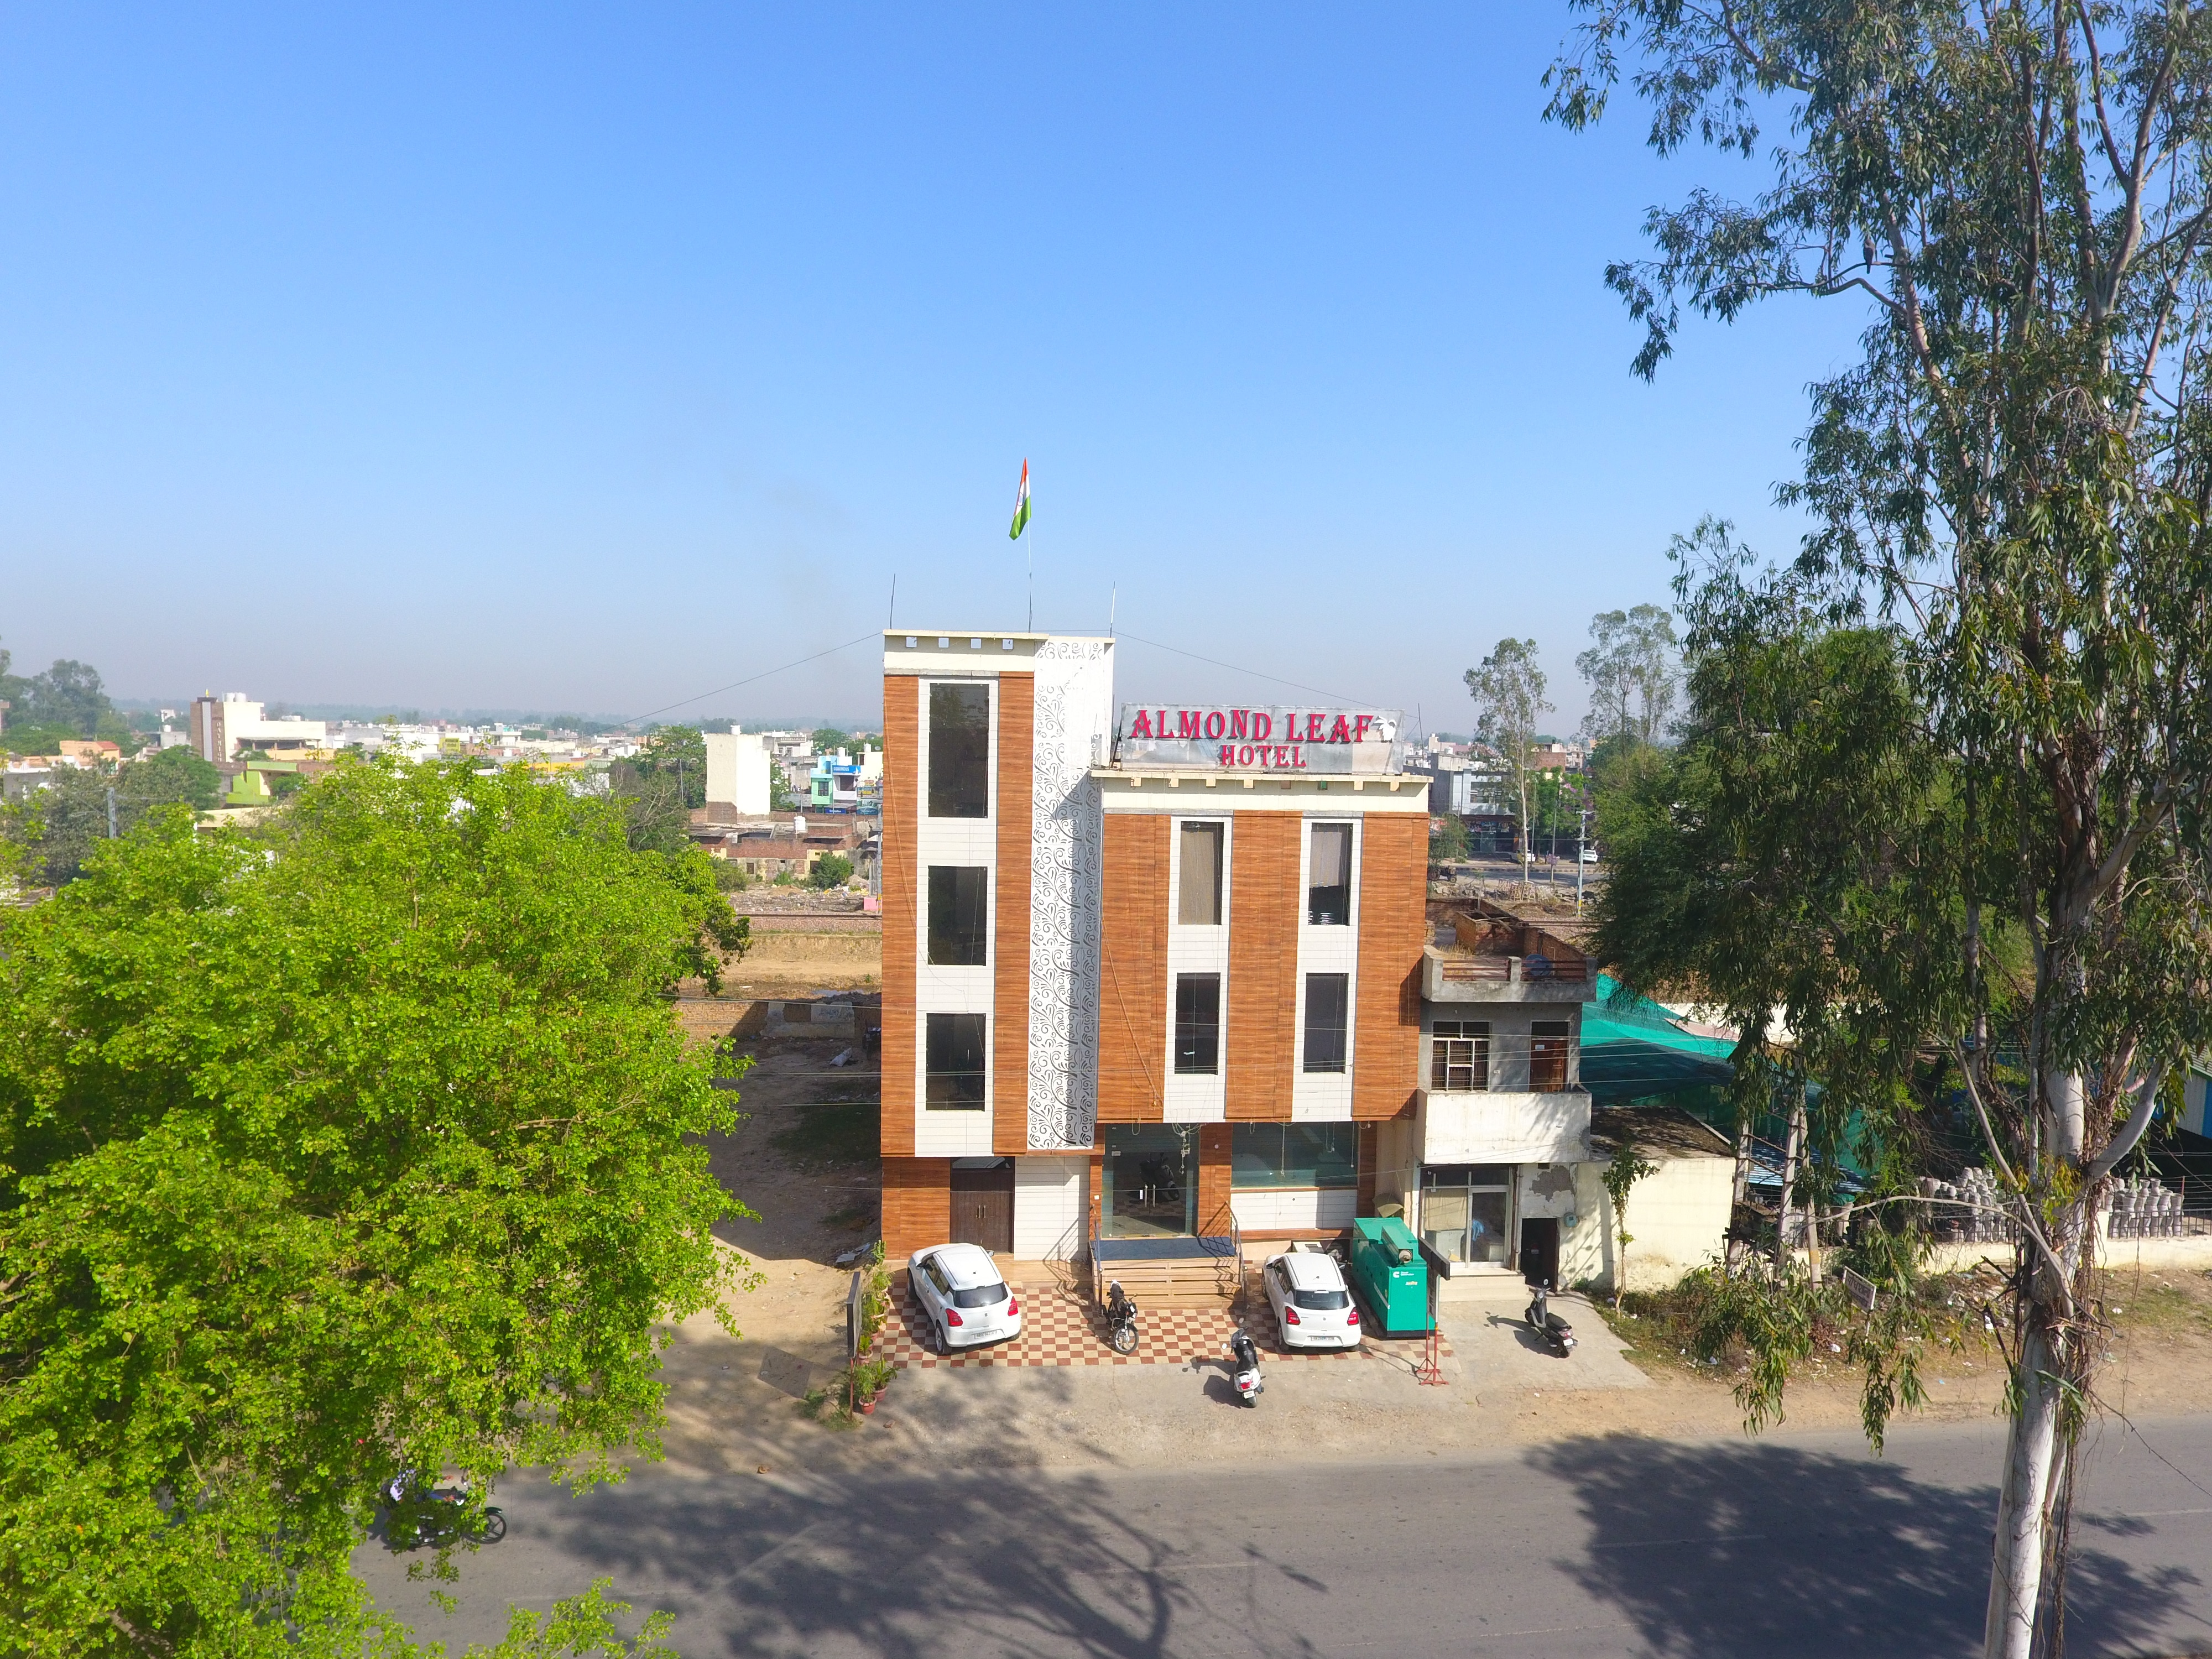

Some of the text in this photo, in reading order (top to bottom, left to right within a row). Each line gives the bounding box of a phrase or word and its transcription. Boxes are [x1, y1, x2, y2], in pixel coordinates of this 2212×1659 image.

[1131, 709, 1374, 742] ALMOND LEAF
[1220, 745, 1307, 767] HOTEL
